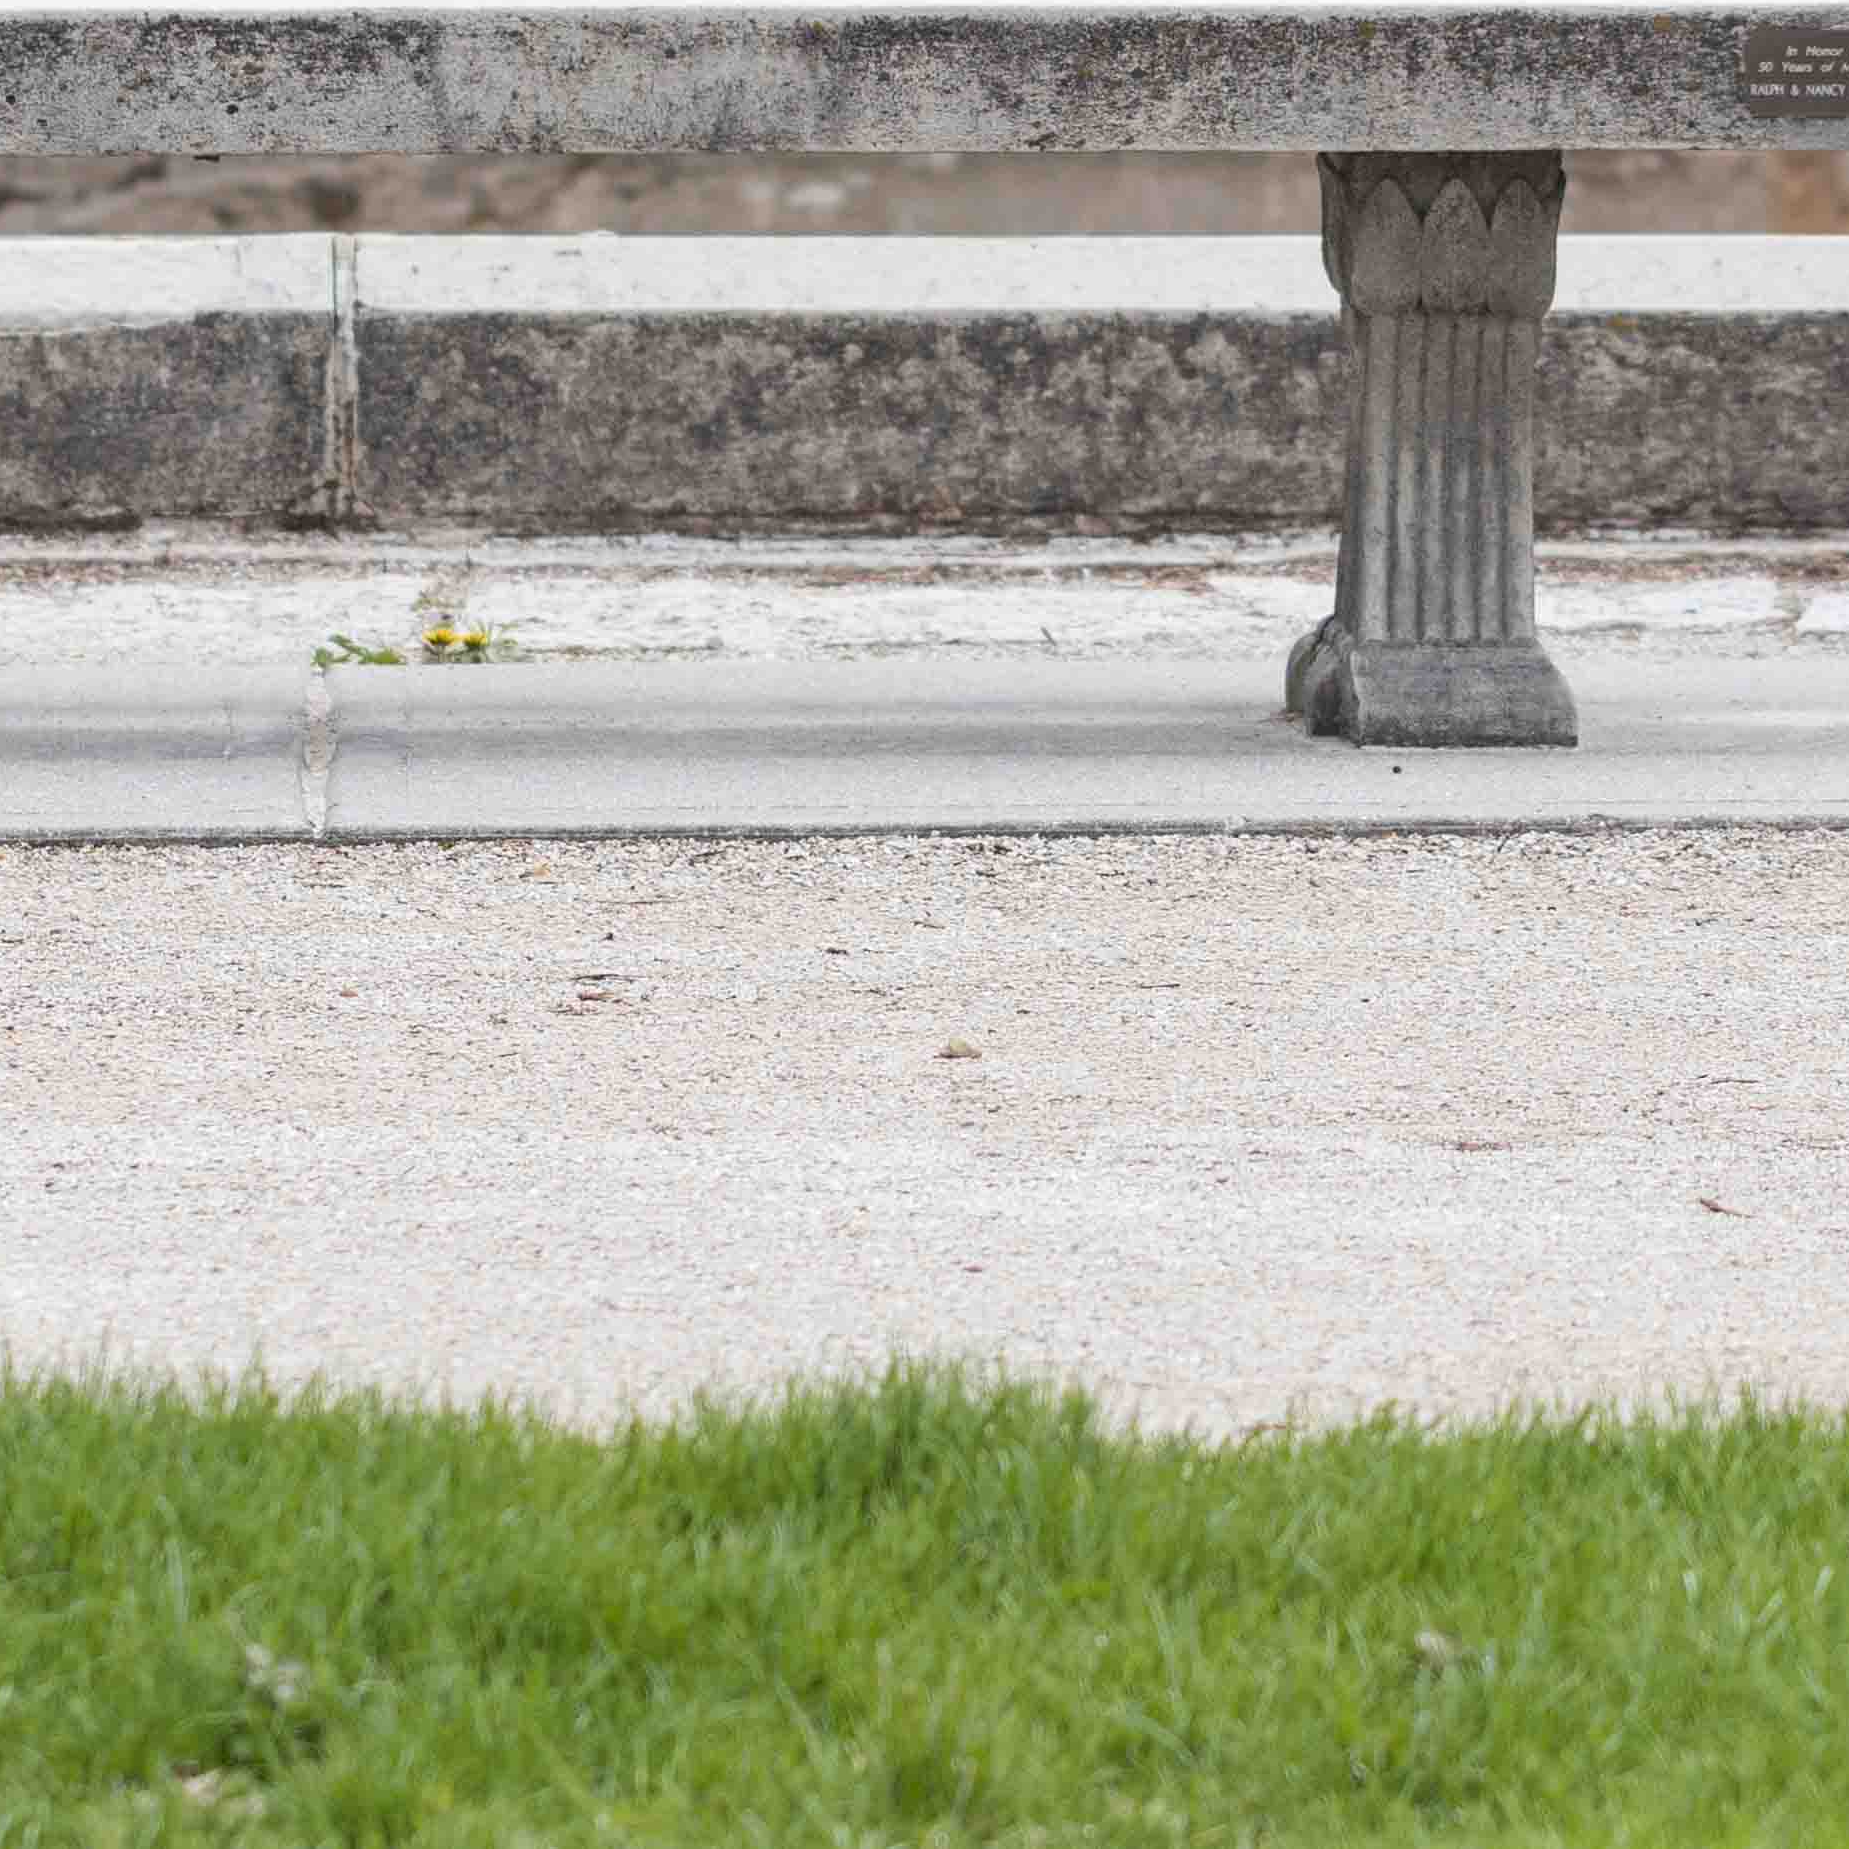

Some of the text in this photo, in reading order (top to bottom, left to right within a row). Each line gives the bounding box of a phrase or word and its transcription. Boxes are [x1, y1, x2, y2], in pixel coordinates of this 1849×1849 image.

[1785, 46, 1798, 57] In
[1805, 46, 1844, 57] Honor
[1758, 62, 1774, 73] 50
[1782, 62, 1814, 73] Years
[1820, 62, 1835, 73] of
[1750, 84, 1785, 96] RALPH
[1790, 84, 1799, 96] &
[1805, 84, 1846, 96] NANCY
